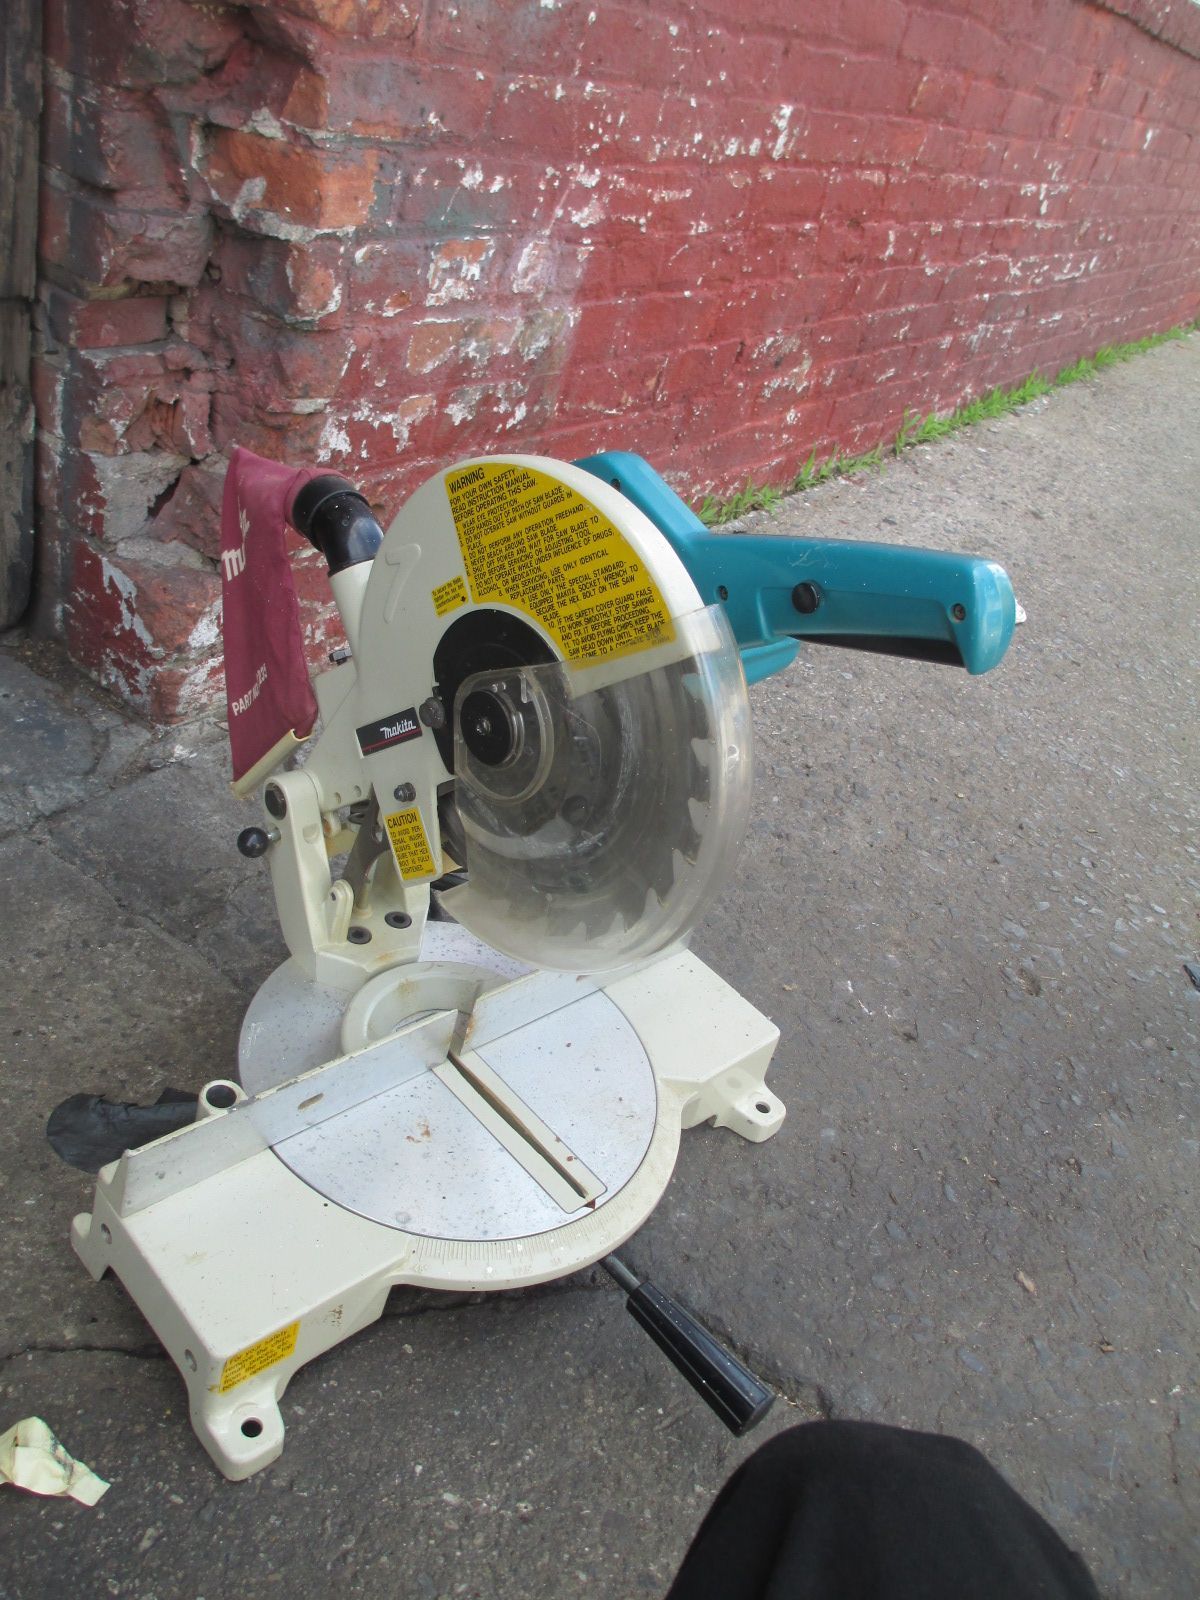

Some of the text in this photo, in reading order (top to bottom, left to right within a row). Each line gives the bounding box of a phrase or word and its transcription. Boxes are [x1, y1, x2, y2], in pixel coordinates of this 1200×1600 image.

[449, 468, 485, 494] WARNING
[450, 469, 515, 506] FOR YOUR OWN SAFETY
[452, 472, 531, 515] READ INSTRUCTION MANUAL
[454, 510, 474, 523] BEFORE
[476, 493, 507, 512] OPERATING
[508, 488, 522, 497] THIS
[463, 526, 476, 536] KEEP
[476, 521, 492, 529] HANDS
[493, 514, 503, 523] OUT
[511, 504, 525, 514] PATH
[533, 494, 544, 505] SAW
[474, 531, 483, 539] NOT
[484, 521, 505, 535] OPERATE
[506, 517, 517, 526] SAW
[519, 505, 541, 520] WITHOUT
[542, 494, 564, 509] GUARDS
[462, 518, 475, 529] WEAR
[478, 546, 487, 555] NOT
[489, 536, 511, 549] PERFORM
[513, 531, 523, 539] ANY
[525, 518, 554, 534] OPERATION
[471, 533, 538, 566] NEVER REACH AROUND SAW
[473, 564, 485, 574] SHUT
[497, 551, 515, 564] POWER
[517, 546, 526, 555] AND
[529, 541, 541, 550] WAIT
[543, 535, 554, 544] FOR
[556, 528, 568, 537] SAW
[570, 519, 588, 533] BLADE
[590, 515, 599, 524] TO
[474, 572, 486, 582] STOP
[488, 564, 506, 576] BEFORE
[508, 552, 533, 568] SERVICING
[545, 535, 574, 552] ADJUSTING
[484, 577, 494, 585] NOT
[495, 567, 516, 581] OPERATE
[518, 560, 533, 571] WHILE
[535, 553, 552, 566] UNDER
[553, 541, 583, 558] INFLUENCE
[505, 584, 520, 594] WHEN
[551, 567, 561, 576] USE
[563, 560, 577, 571] ONLY
[579, 549, 608, 565] IDENTICAL
[510, 582, 546, 600] REPLACEMENT
[528, 561, 627, 602] USE ONLY THE SPECIAL STANDARD-
[530, 596, 554, 610] EQUIPPED
[556, 589, 576, 600] MAKITA
[578, 578, 600, 592] SOCKET
[603, 568, 627, 582] WRENCH
[536, 604, 555, 616] SECURE
[557, 600, 567, 608] THE
[583, 589, 596, 600] BOLT
[598, 585, 607, 594] ON
[609, 580, 619, 589] THE
[622, 575, 635, 585] SAW
[564, 614, 574, 622] THE
[574, 608, 594, 618] SAFETY
[595, 601, 614, 612] COVER
[615, 593, 635, 605] GUARD
[636, 587, 652, 598] FAILS
[568, 621, 582, 631] WORK
[615, 604, 630, 614] STOP
[631, 596, 654, 608] SAWING
[561, 632, 572, 641] AND
[591, 619, 612, 631] BEFORE
[569, 648, 580, 656] SAW
[581, 642, 595, 652] HEAD
[597, 636, 614, 648] DOWN
[615, 630, 632, 643] UNTIL
[633, 626, 645, 635] THE
[581, 632, 596, 643] AVOID
[597, 627, 616, 638] FLYING
[635, 616, 649, 625] KEEP
[651, 611, 663, 620] THE
[599, 647, 608, 655] TO
[232, 689, 252, 716] PART
[387, 812, 418, 829] CAUTION
